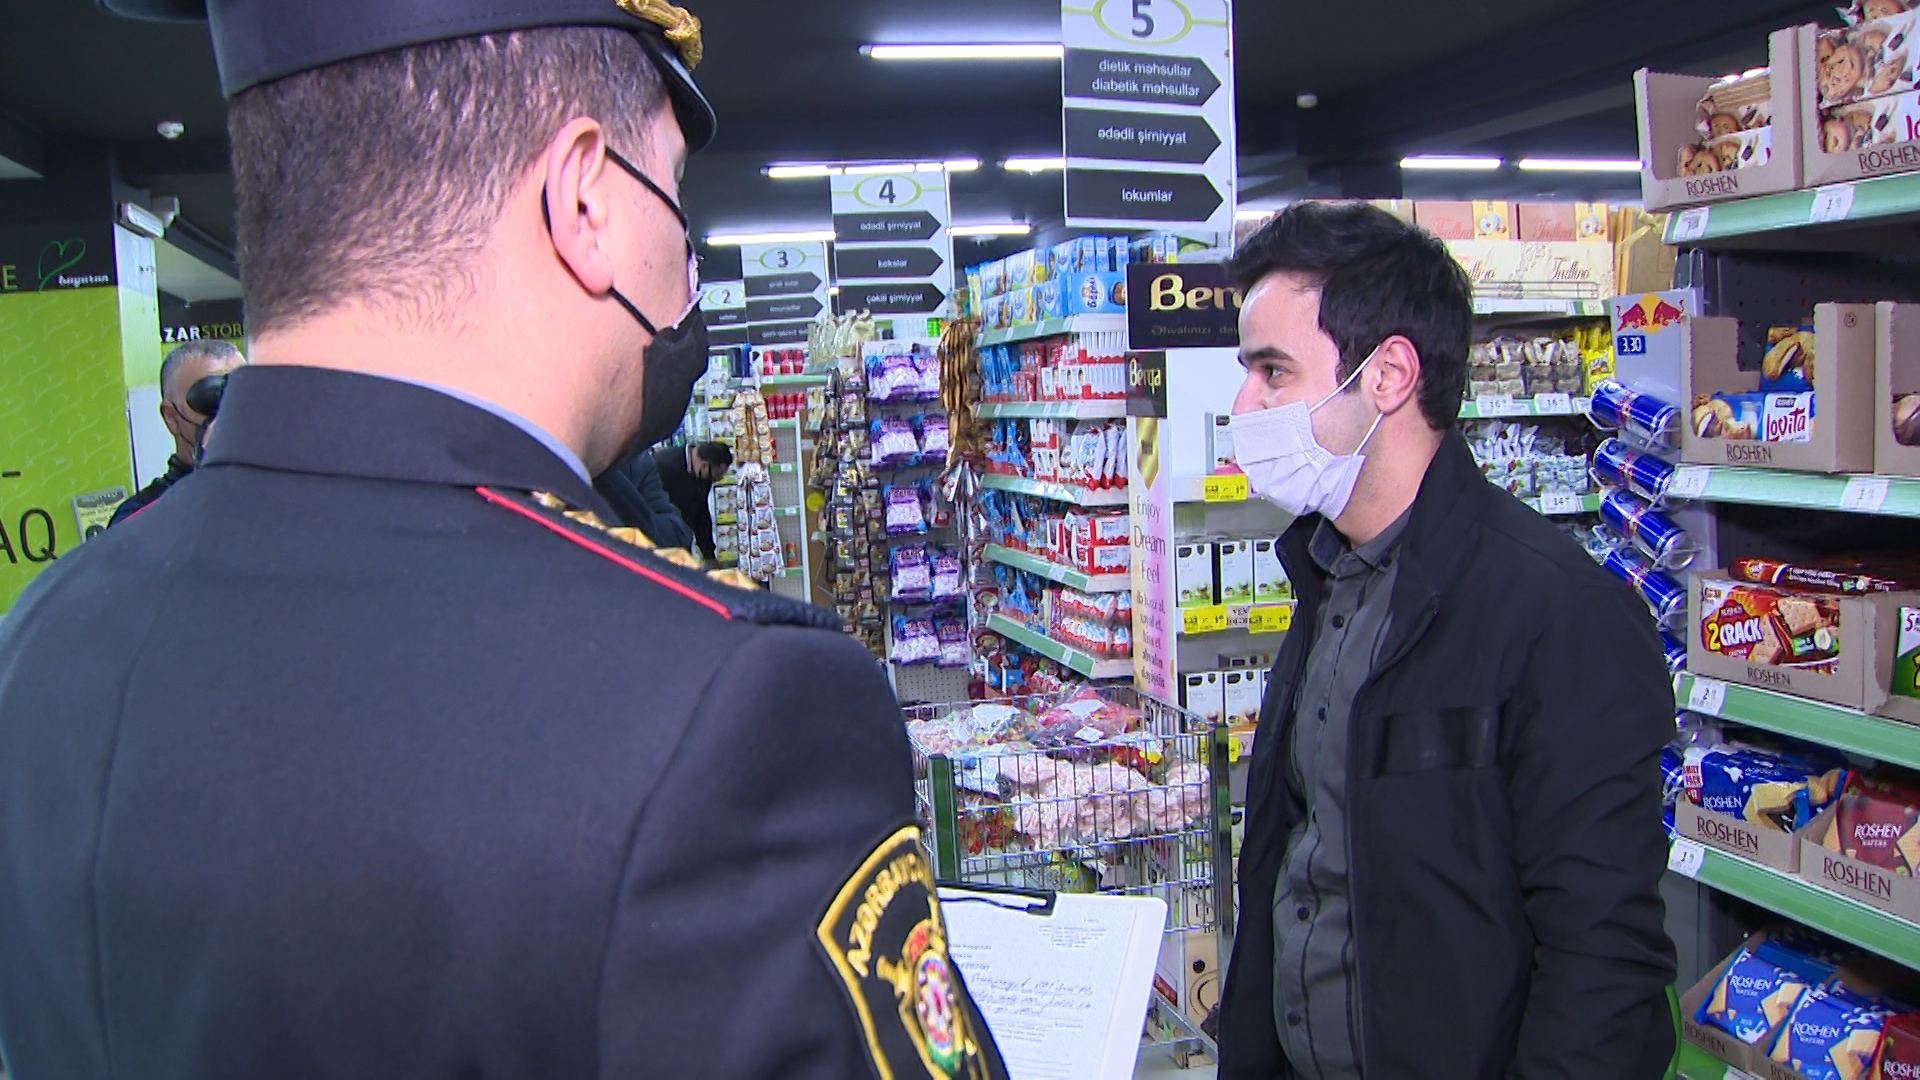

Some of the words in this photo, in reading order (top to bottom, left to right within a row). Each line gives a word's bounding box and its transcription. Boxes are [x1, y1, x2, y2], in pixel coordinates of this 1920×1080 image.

[1131, 0, 1154, 38] 5
[1099, 59, 1131, 74] dietik
[1092, 78, 1138, 91] diabetik
[1098, 128, 1134, 140] ədədli
[879, 179, 896, 204] 4
[1122, 188, 1173, 202] lokumlar
[1686, 175, 1738, 198] ROSHEN
[777, 251, 788, 268] 3
[722, 289, 732, 303] 2
[1726, 443, 1772, 462] ROSHEN
[1136, 495, 1161, 522] Enjoy
[1133, 525, 1166, 556] Dream
[1141, 560, 1160, 584] Feel
[1747, 667, 1791, 687] ROSHEN
[1703, 796, 1742, 810] ROSHEN
[1697, 815, 1759, 851] ROSHEN
[1855, 823, 1901, 840] ROSHEN
[1823, 856, 1892, 898] ROSHEN
[1730, 975, 1772, 990] ROSHEN
[1684, 1021, 1726, 1054] ROSHEN
[1792, 1022, 1841, 1038] ROSHEN
